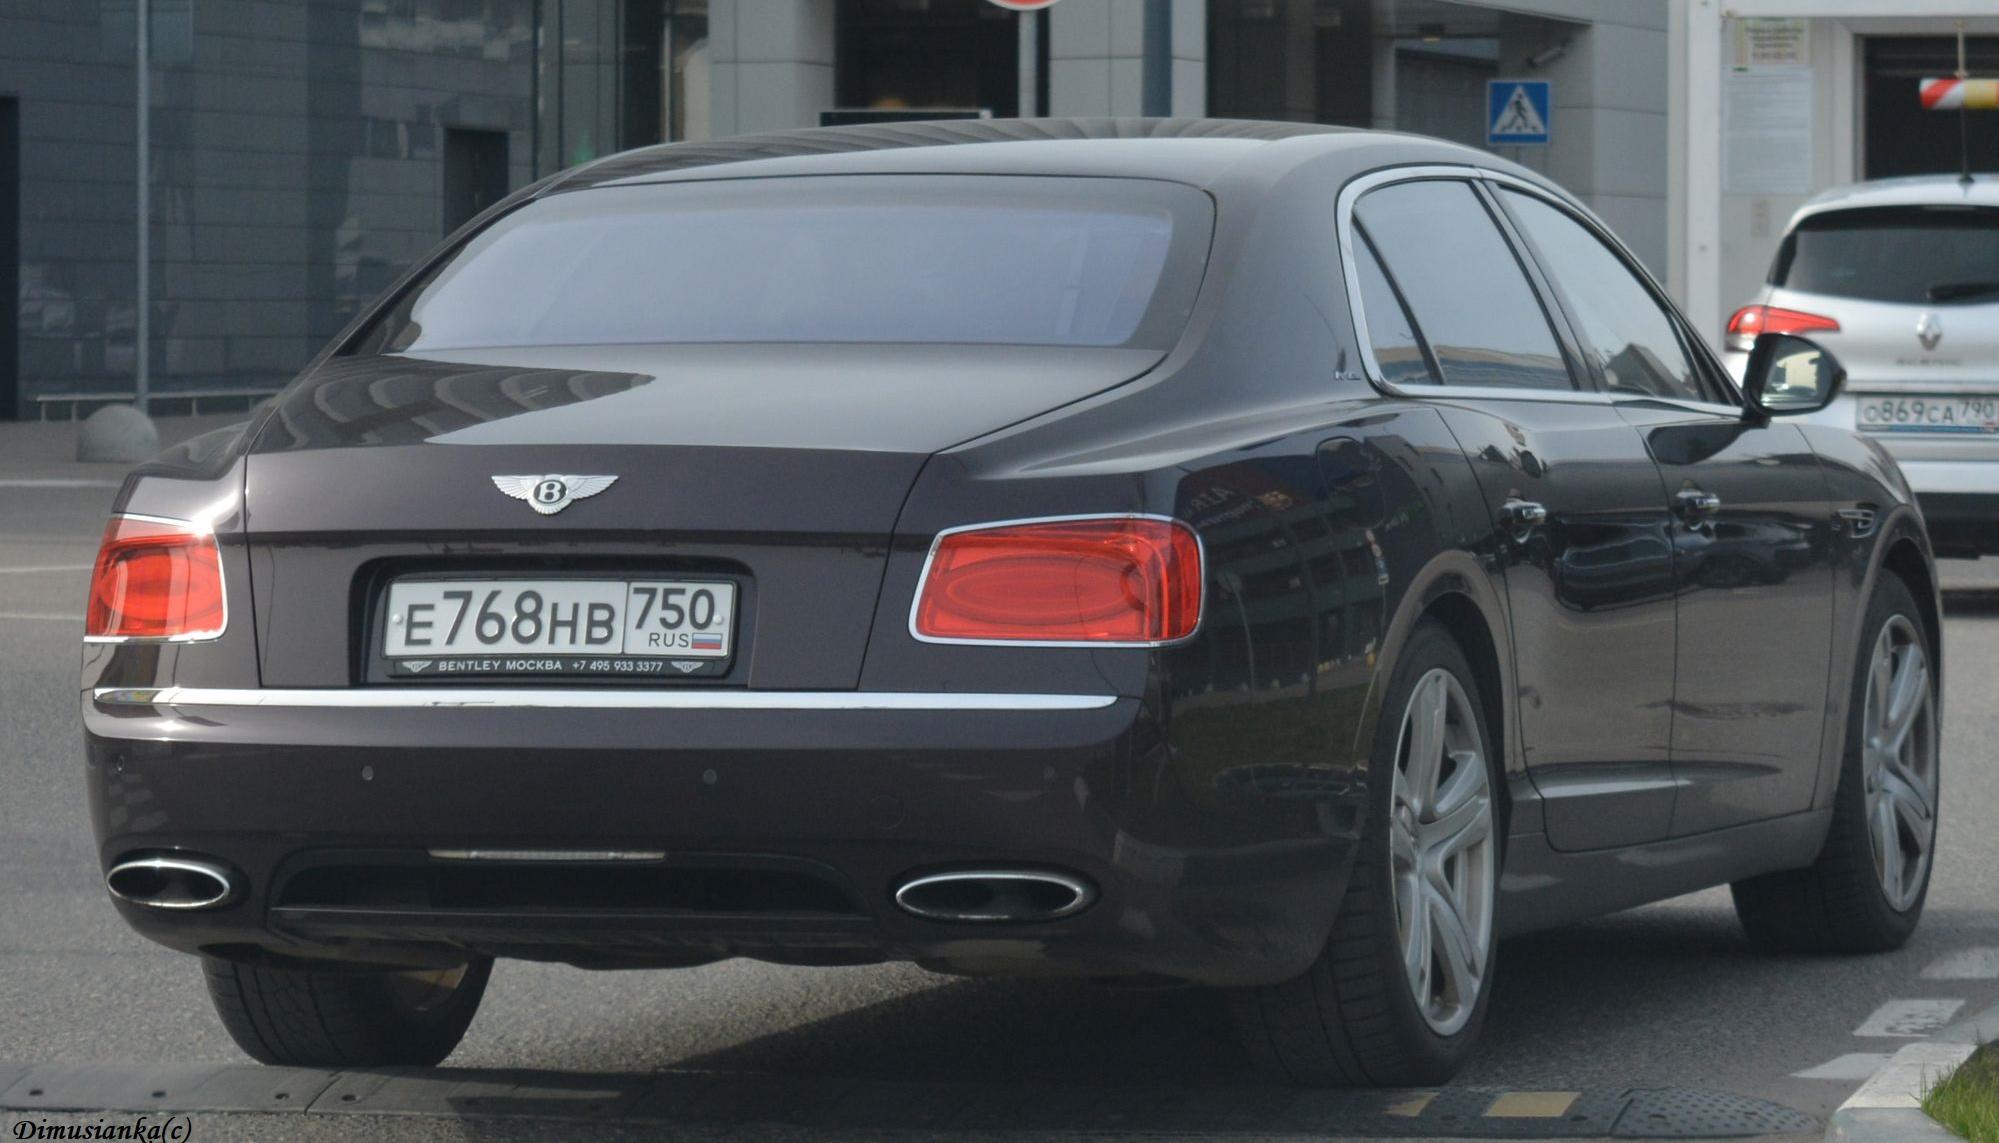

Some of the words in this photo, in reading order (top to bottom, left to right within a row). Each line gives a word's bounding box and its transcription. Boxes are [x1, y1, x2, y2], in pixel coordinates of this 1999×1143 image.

[632, 587, 716, 631] 750
[648, 632, 690, 649] RUS
[438, 661, 501, 672] BENTLEY
[572, 661, 586, 672] +7
[590, 661, 610, 672] 495
[614, 661, 634, 672] 933
[636, 661, 663, 672] 3377
